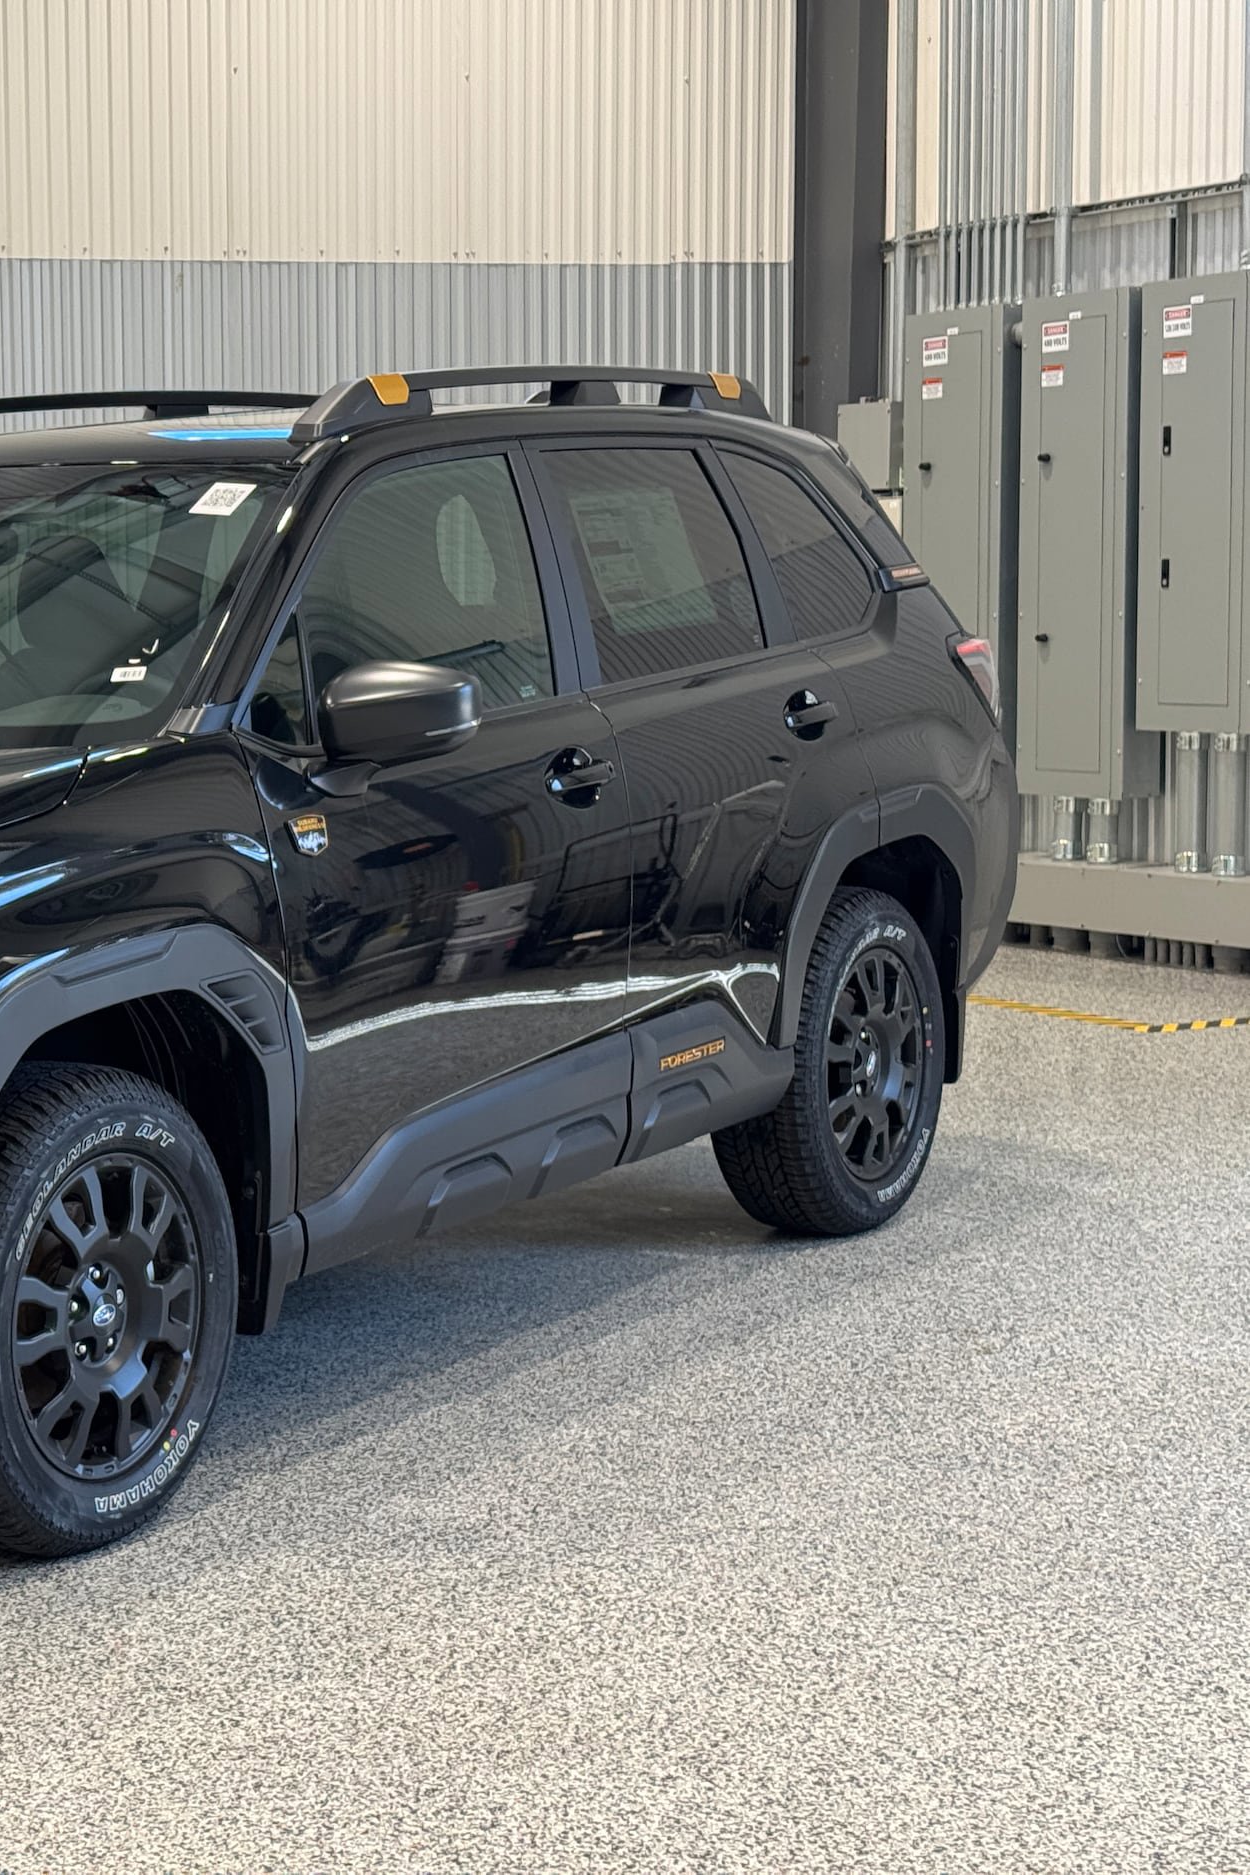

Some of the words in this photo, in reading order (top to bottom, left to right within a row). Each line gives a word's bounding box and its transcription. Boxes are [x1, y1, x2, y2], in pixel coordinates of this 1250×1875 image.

[1054, 336, 1067, 346] VOLTS
[933, 351, 946, 360] VOLTS
[882, 924, 907, 941] A/T
[659, 1038, 726, 1072] FORESTER
[15, 1121, 127, 1261] GEOLANDAR
[135, 1122, 175, 1148] A/T
[94, 1419, 200, 1513] YOKOHAMA
